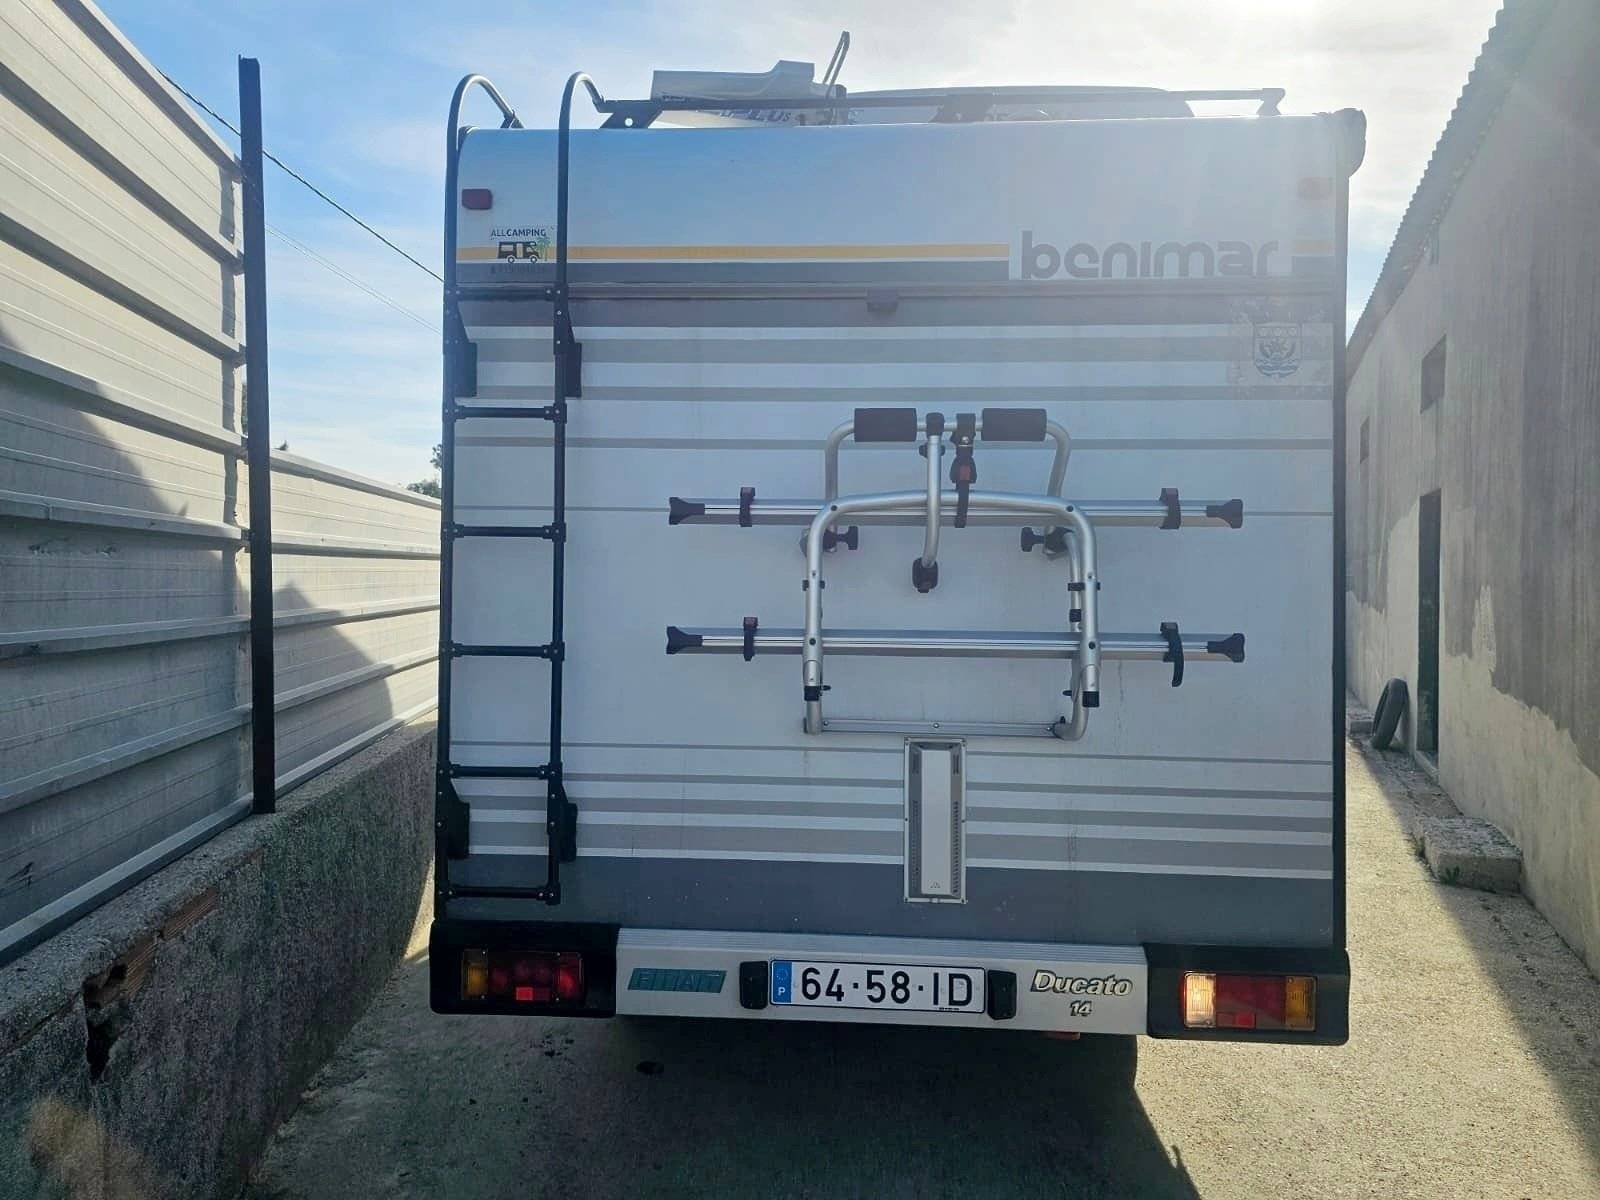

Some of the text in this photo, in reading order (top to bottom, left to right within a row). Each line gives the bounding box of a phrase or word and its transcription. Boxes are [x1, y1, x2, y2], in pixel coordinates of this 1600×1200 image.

[491, 228, 547, 237] ALLCAMPING
[1021, 229, 1279, 280] benimar
[778, 986, 786, 996] P
[1030, 969, 1134, 996] Ducato
[1070, 1000, 1092, 1017] 14
